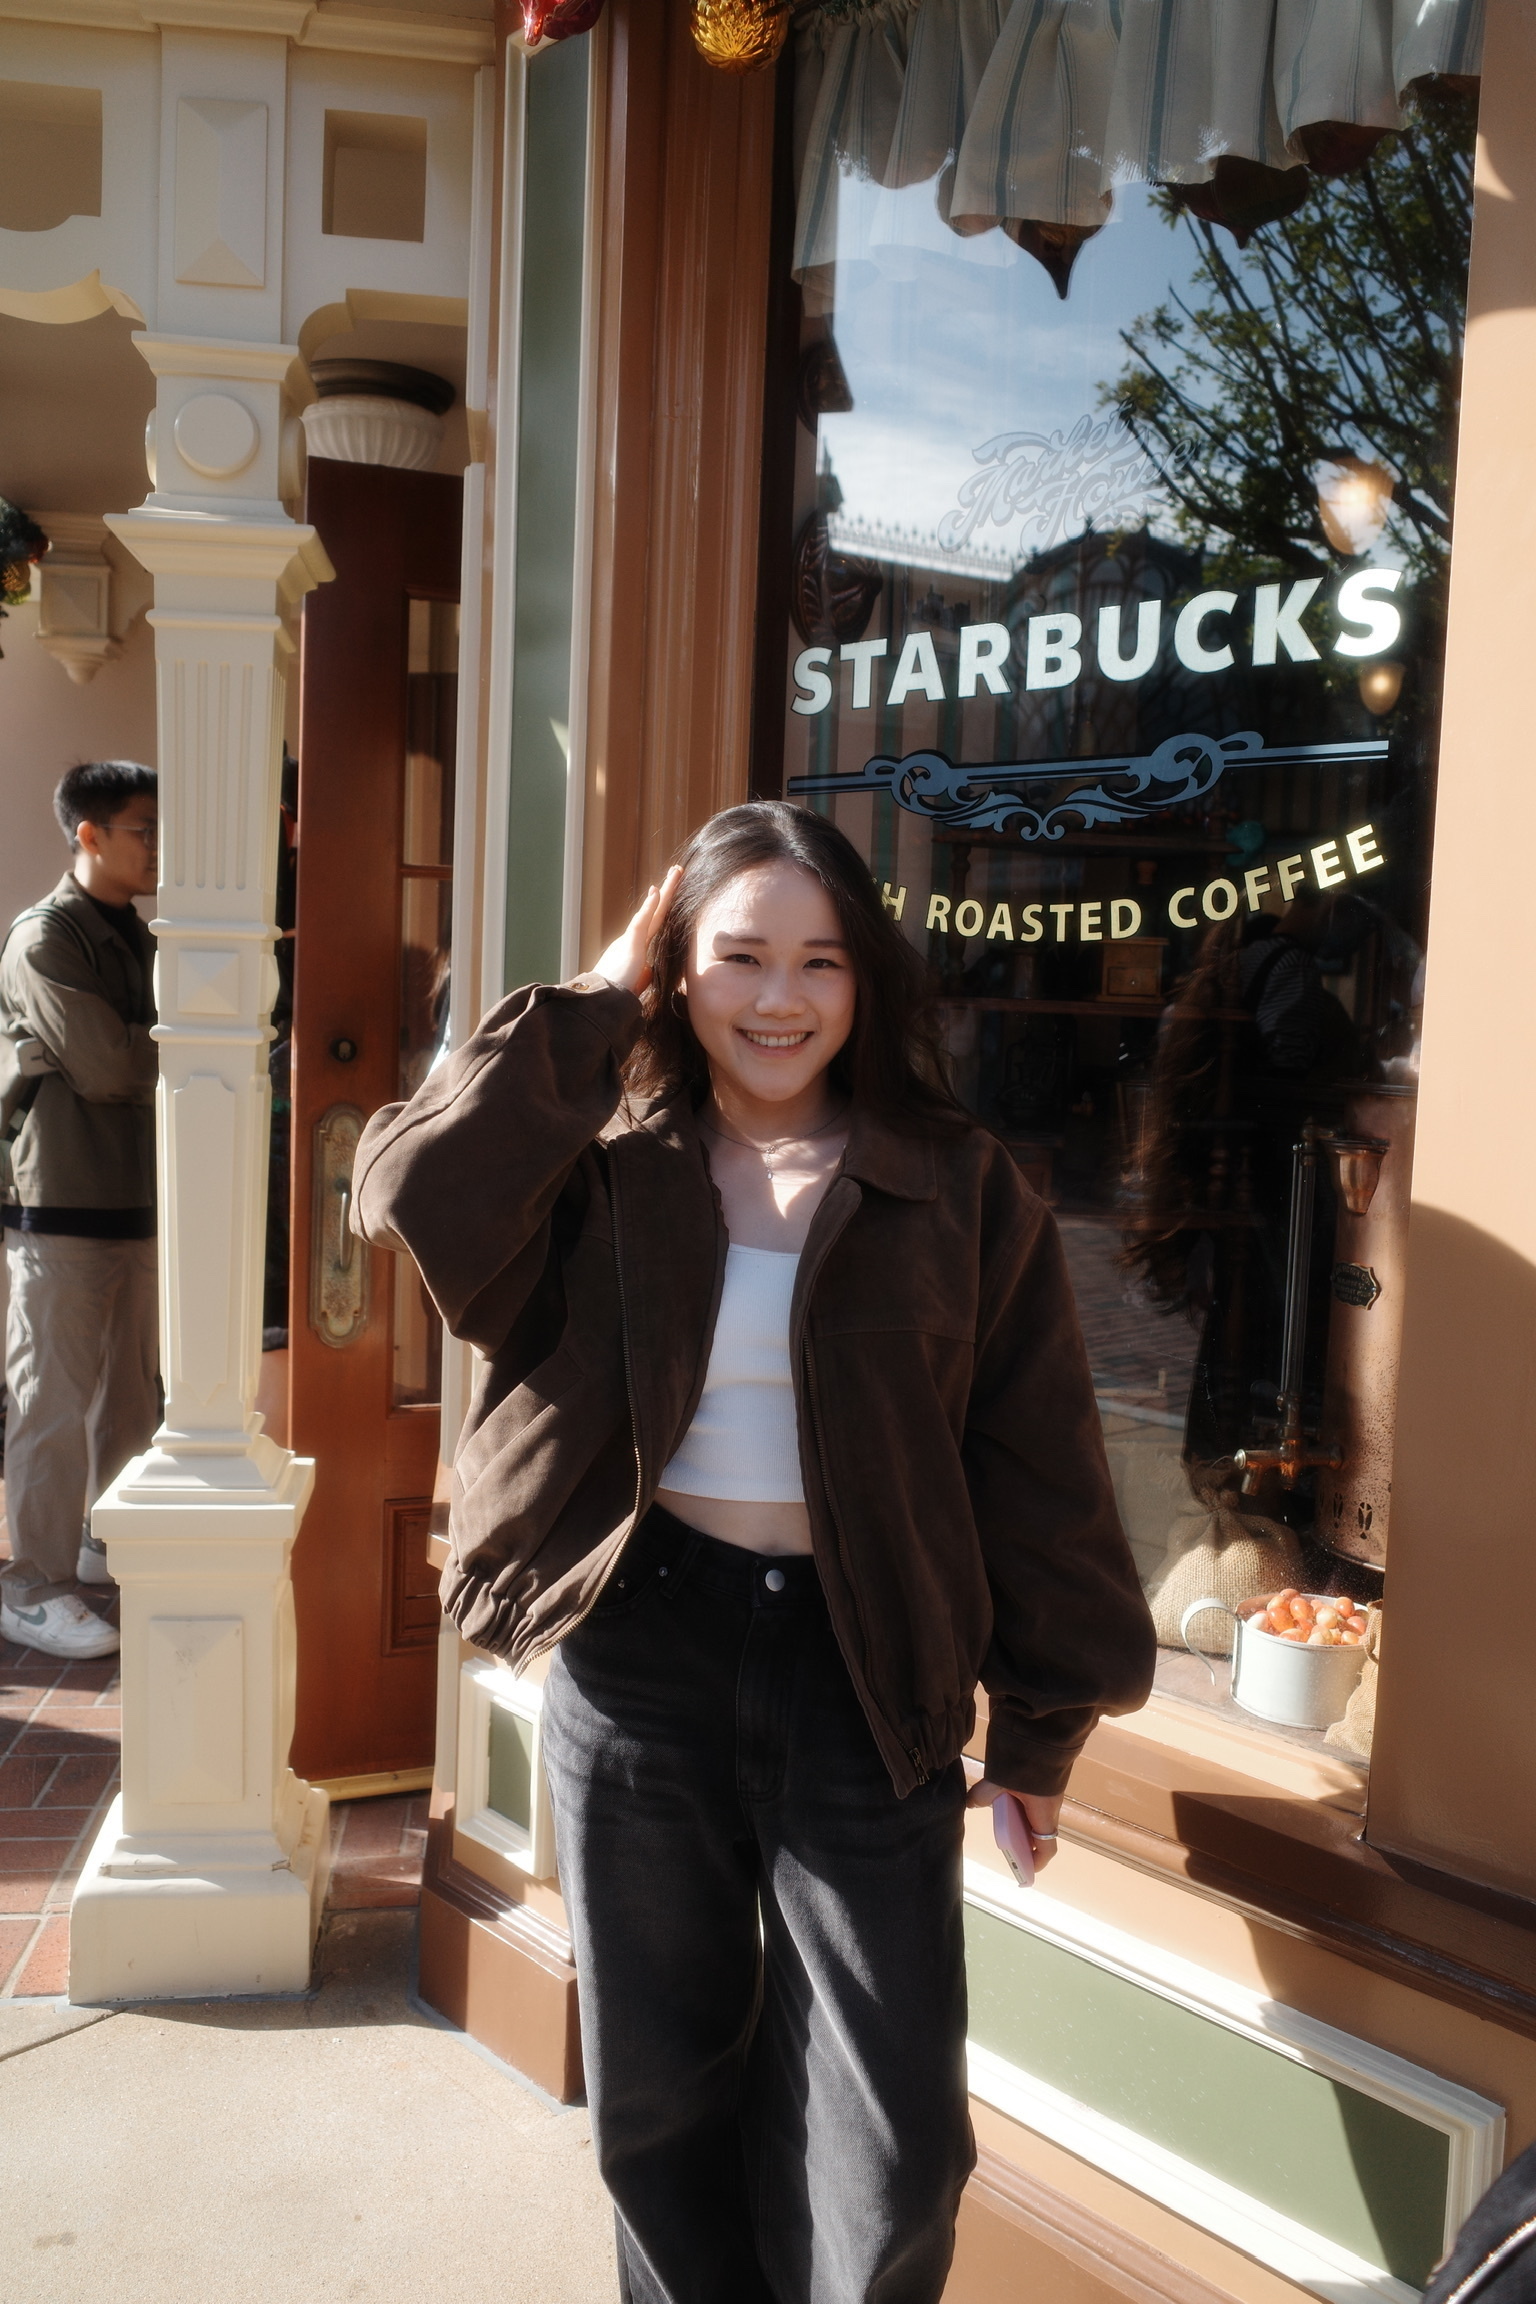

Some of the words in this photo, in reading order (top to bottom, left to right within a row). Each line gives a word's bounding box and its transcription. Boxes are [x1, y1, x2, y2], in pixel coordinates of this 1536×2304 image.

[938, 399, 1149, 552] Market
[1020, 436, 1200, 557] House
[791, 568, 1402, 716] STARBUCKS
[872, 877, 907, 922] H
[925, 892, 1143, 943] ROASTED
[1167, 824, 1387, 929] COFFEE
